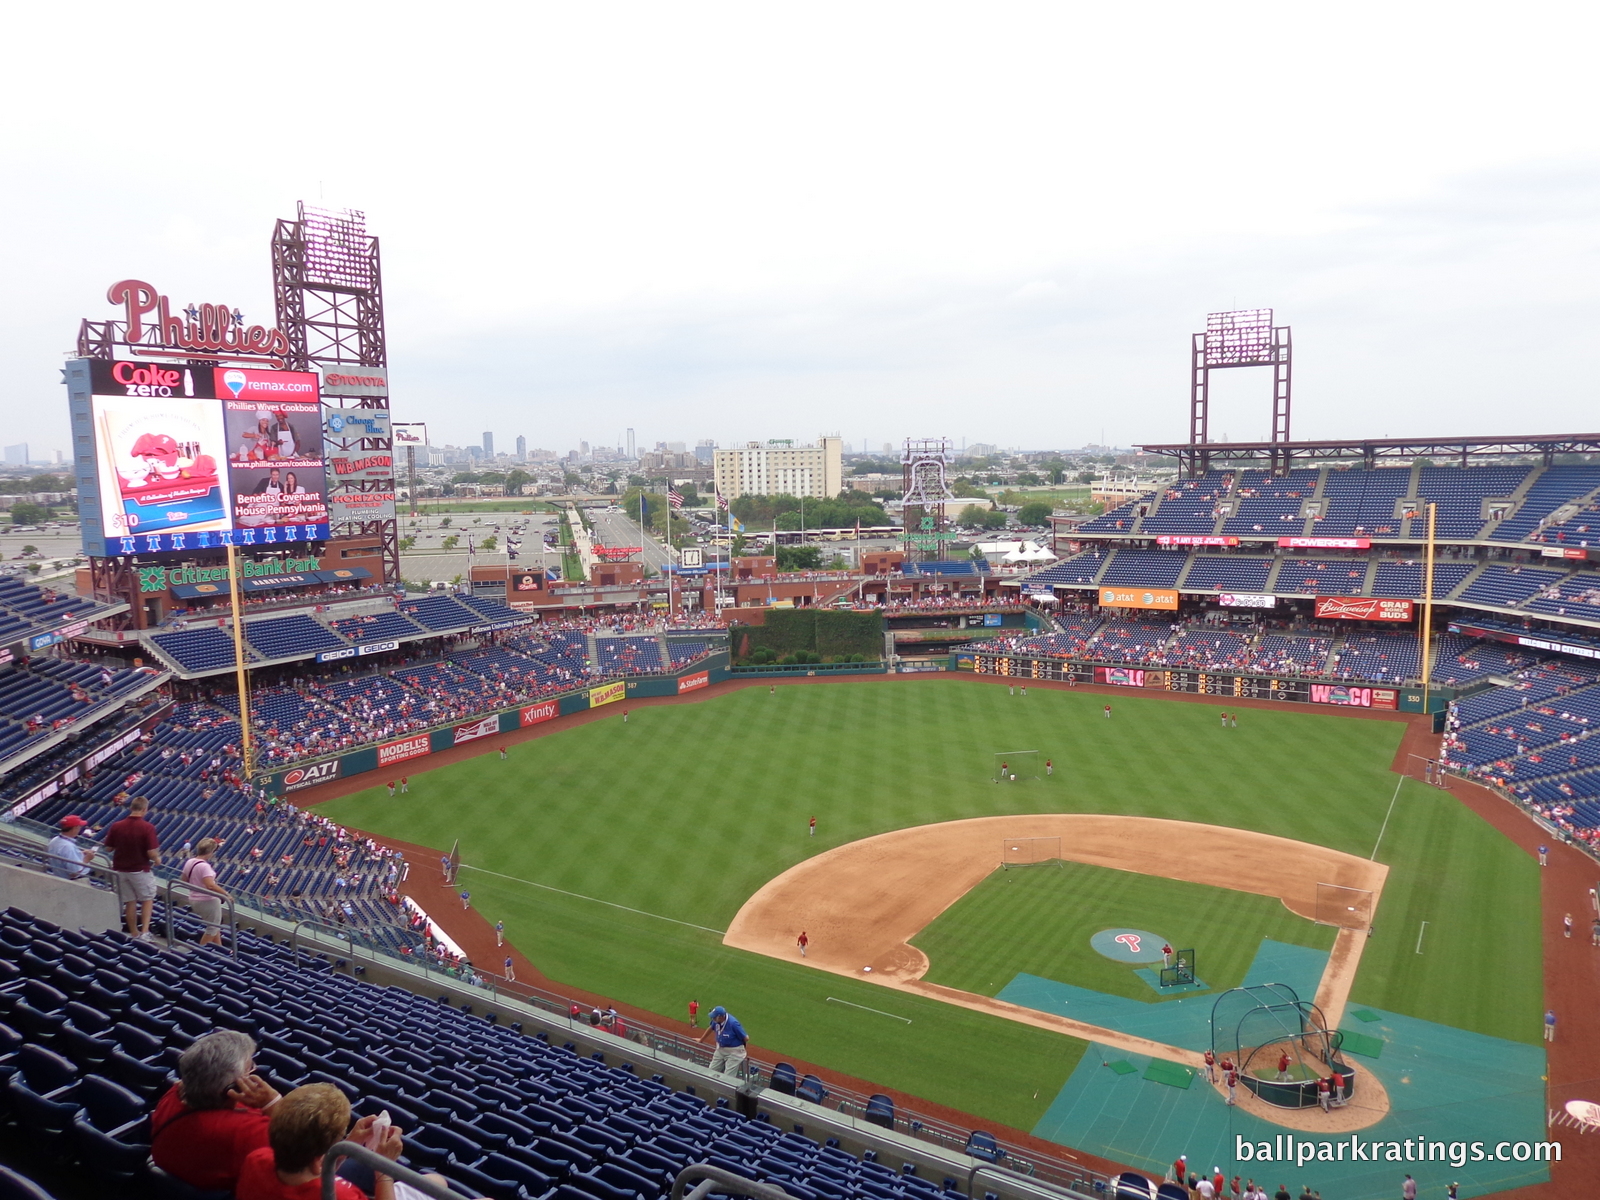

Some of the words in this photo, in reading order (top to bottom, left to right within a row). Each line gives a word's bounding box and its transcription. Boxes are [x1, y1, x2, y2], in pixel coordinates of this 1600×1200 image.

[107, 279, 289, 355] Phillies
[112, 362, 180, 386] Coke
[341, 375, 386, 387] TOYOTA
[126, 384, 172, 396] zero
[248, 381, 312, 392] remax.com
[228, 402, 256, 410] Phillies
[257, 402, 280, 411] Wives
[280, 404, 318, 412] Cookbook
[346, 416, 374, 426] Choose
[232, 460, 323, 468] www.phillies.com/cookbook
[238, 494, 275, 504] Benefits
[277, 492, 320, 502] Covenant
[333, 494, 394, 504] HORIZON
[236, 506, 266, 516] House
[267, 502, 325, 515] Pennsylvania
[112, 514, 138, 528] $10
[244, 560, 284, 578] Bank
[286, 556, 320, 573] Park
[1116, 593, 1134, 602] at&t
[1155, 595, 1174, 604] at&t
[1318, 602, 1376, 613] Budweiser
[470, 624, 492, 634] Jefferson
[492, 620, 513, 631] University
[514, 617, 534, 628] Hospitals
[322, 648, 355, 661] GEICO
[364, 642, 395, 654] GEICO
[524, 705, 555, 722] xfinity
[380, 738, 428, 758] MODELL'S
[380, 752, 409, 764] SPORTING
[409, 747, 429, 756] GOODS
[303, 760, 338, 780] ATI
[260, 777, 272, 785] 334
[286, 780, 311, 791] PHYSICAL
[312, 774, 336, 784] THERAPY
